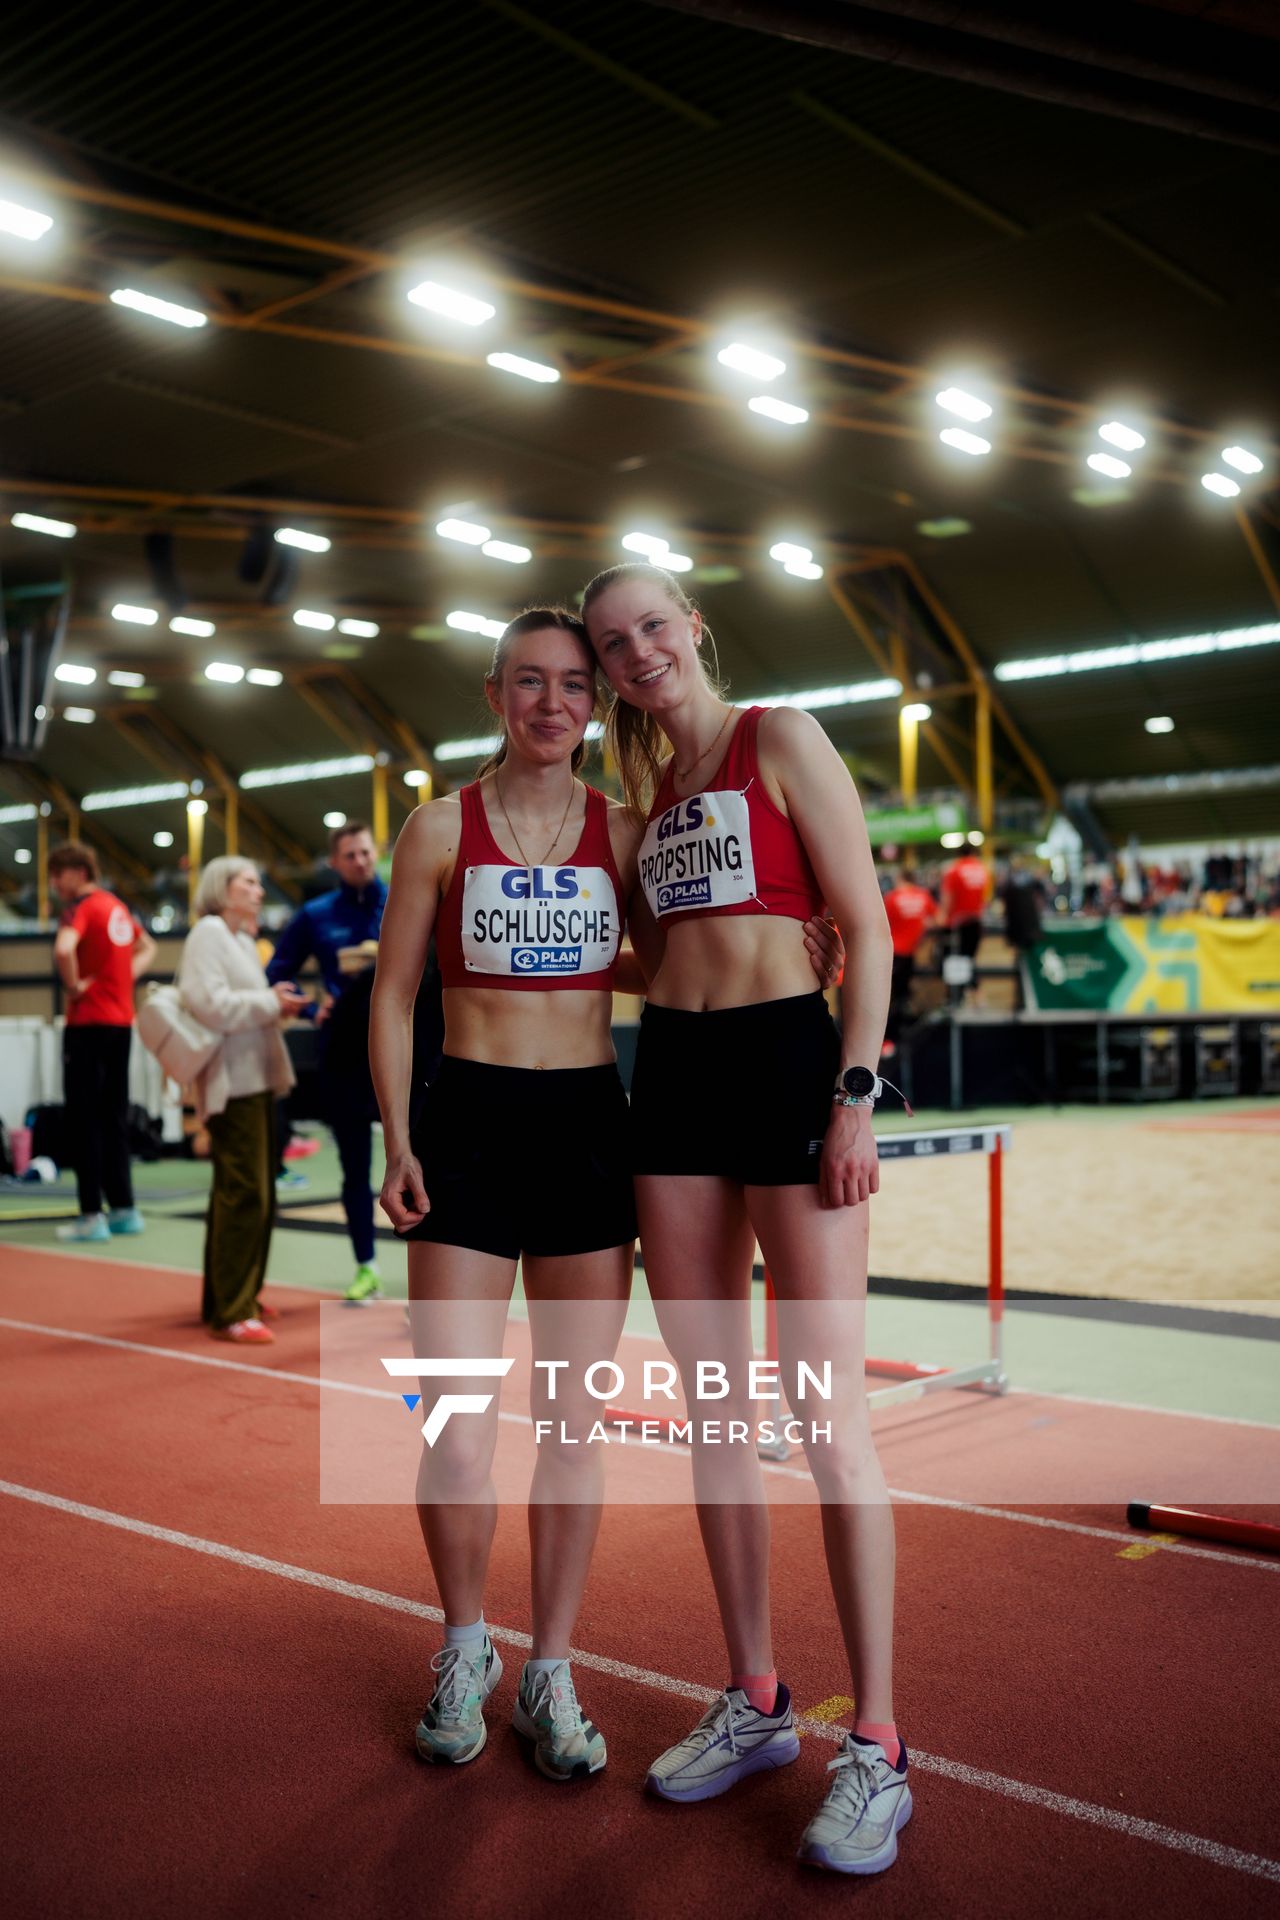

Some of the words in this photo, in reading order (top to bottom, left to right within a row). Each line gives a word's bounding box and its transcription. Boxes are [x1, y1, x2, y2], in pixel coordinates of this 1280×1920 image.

[641, 834, 742, 892] PRÖPSTING
[674, 882, 708, 898] PLAN
[473, 901, 610, 943] SCHLÜSCHE
[541, 951, 579, 963] PLAN
